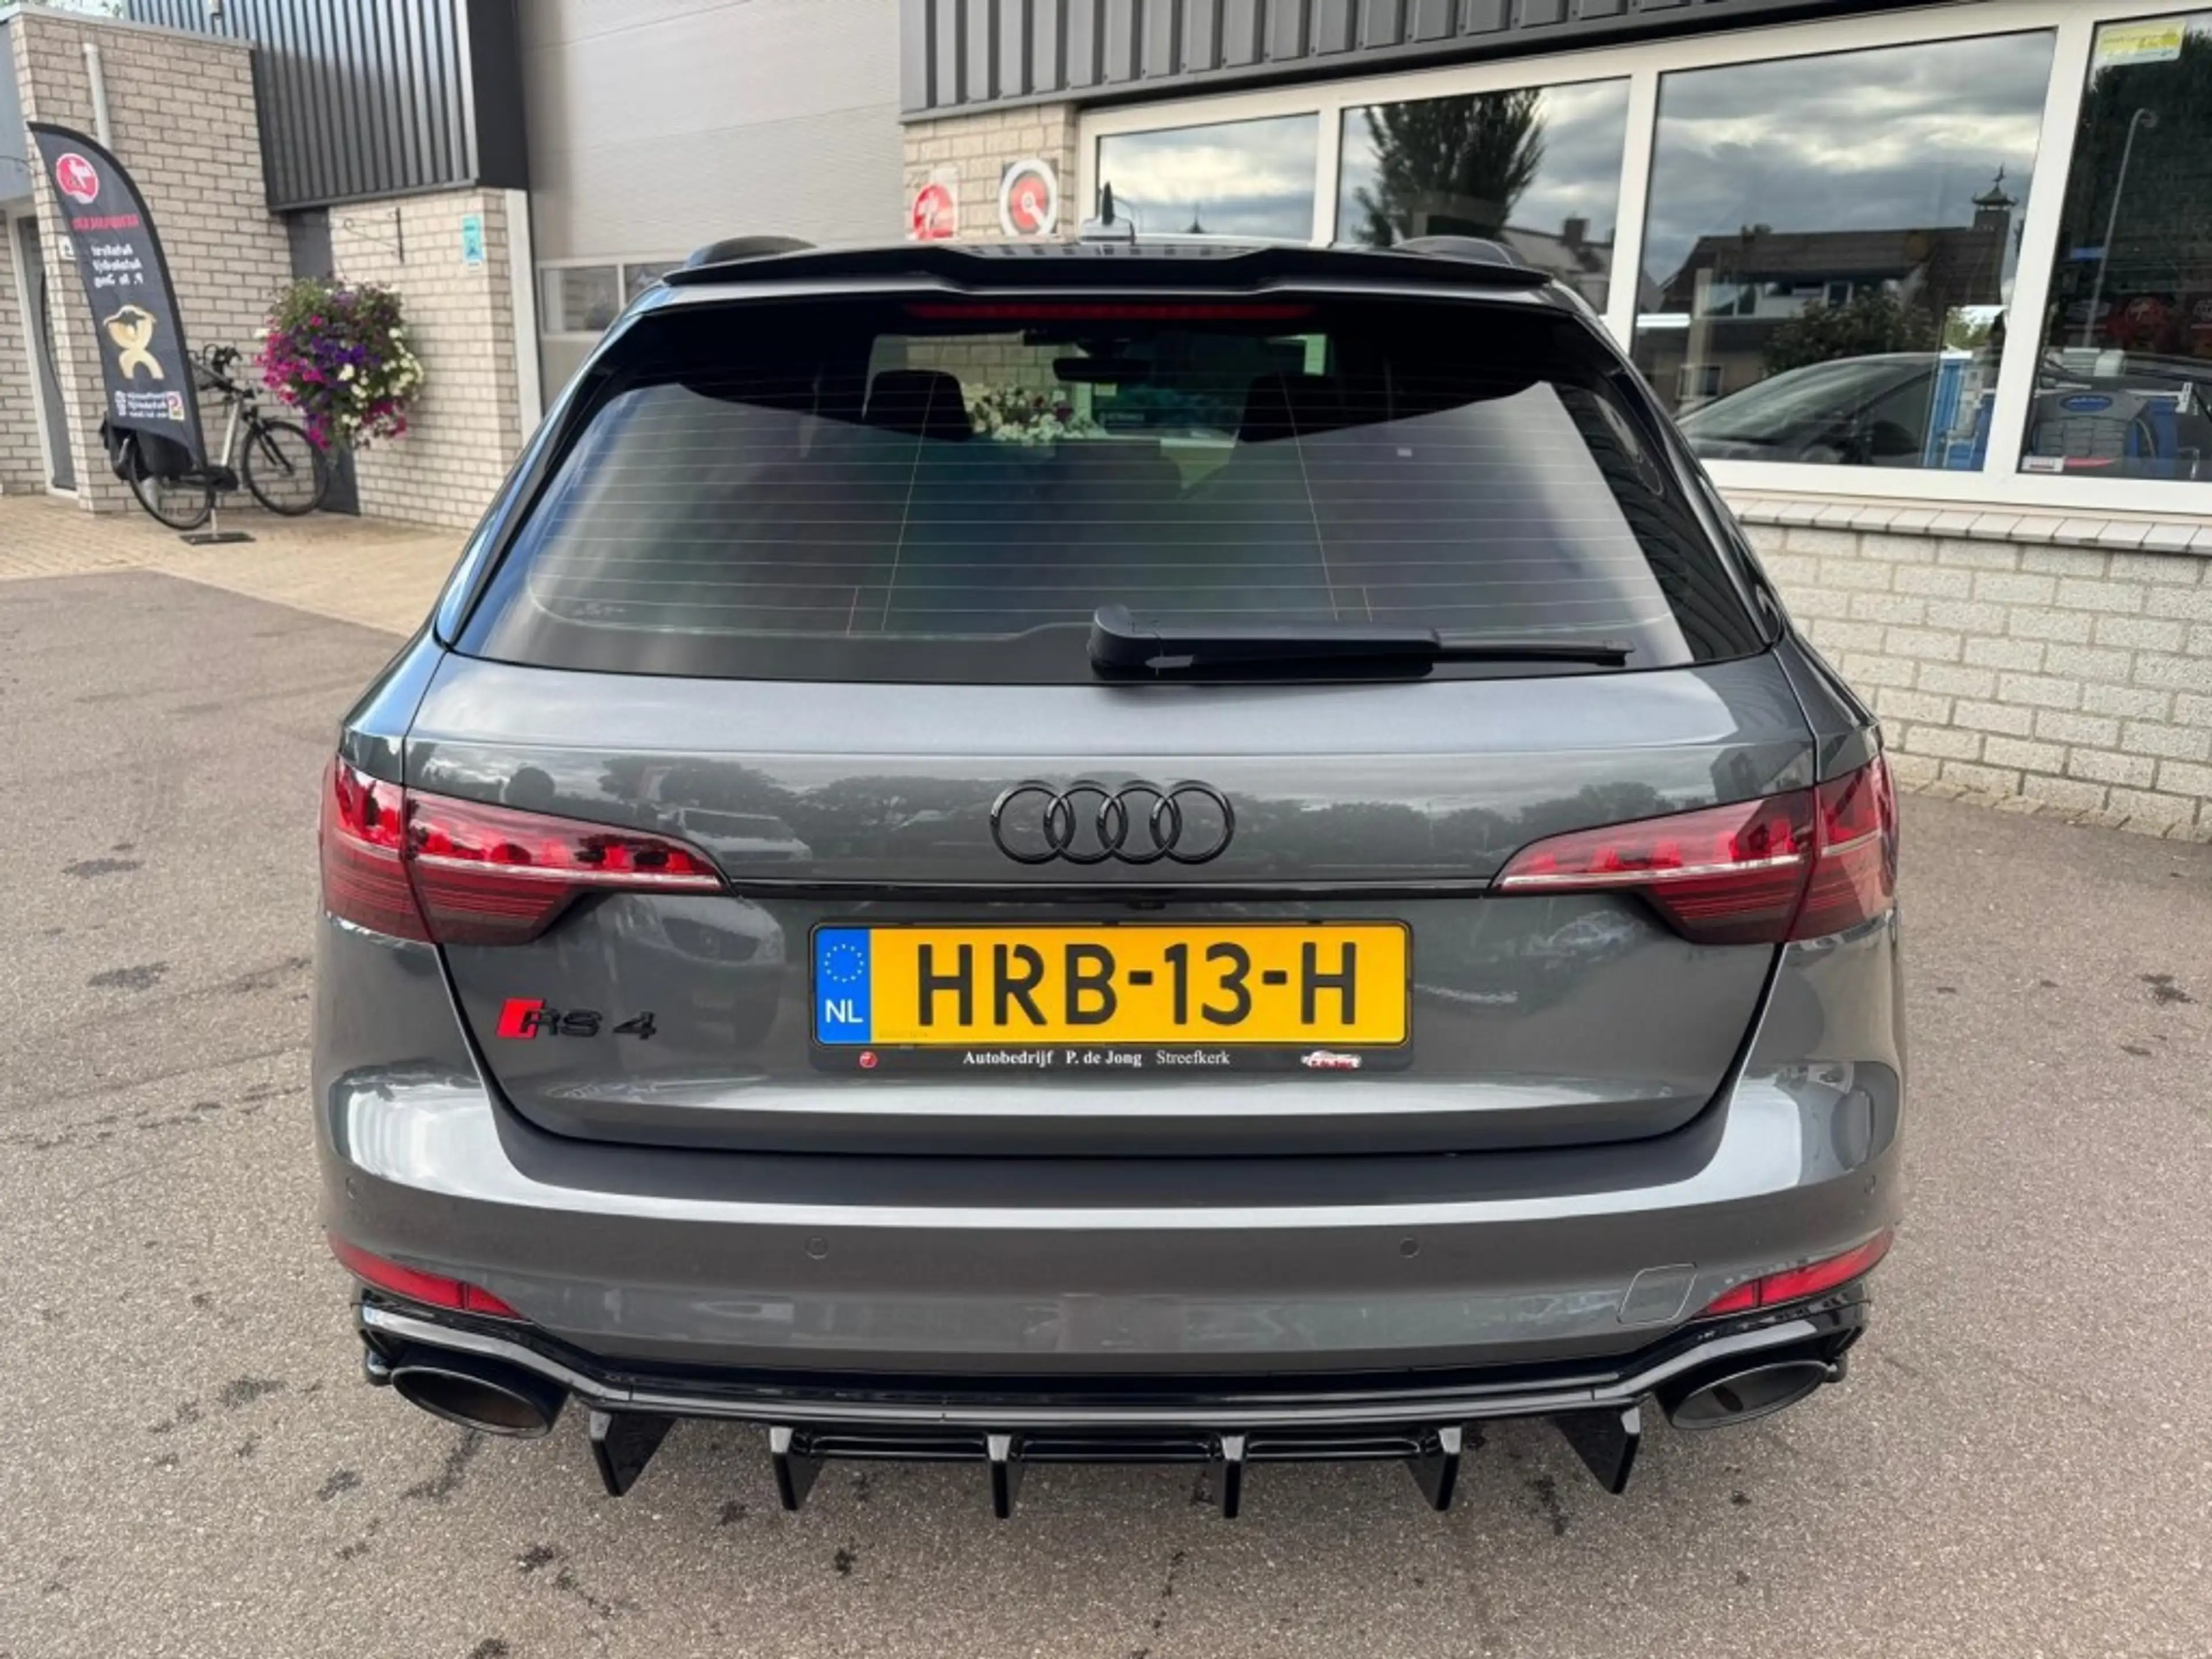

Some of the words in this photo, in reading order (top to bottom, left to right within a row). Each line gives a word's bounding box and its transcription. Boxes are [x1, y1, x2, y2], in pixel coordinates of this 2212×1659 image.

[918, 941, 1357, 1026] HRB-13-H
[519, 1007, 603, 1037] RS
[612, 1011, 657, 1040] 4
[825, 999, 863, 1023] NL
[963, 1050, 1054, 1067] Autobedrijf
[1066, 1050, 1079, 1064] P.
[1084, 1050, 1101, 1064] de
[1105, 1050, 1142, 1067] Jong
[1156, 1050, 1230, 1065] Streefkerk
